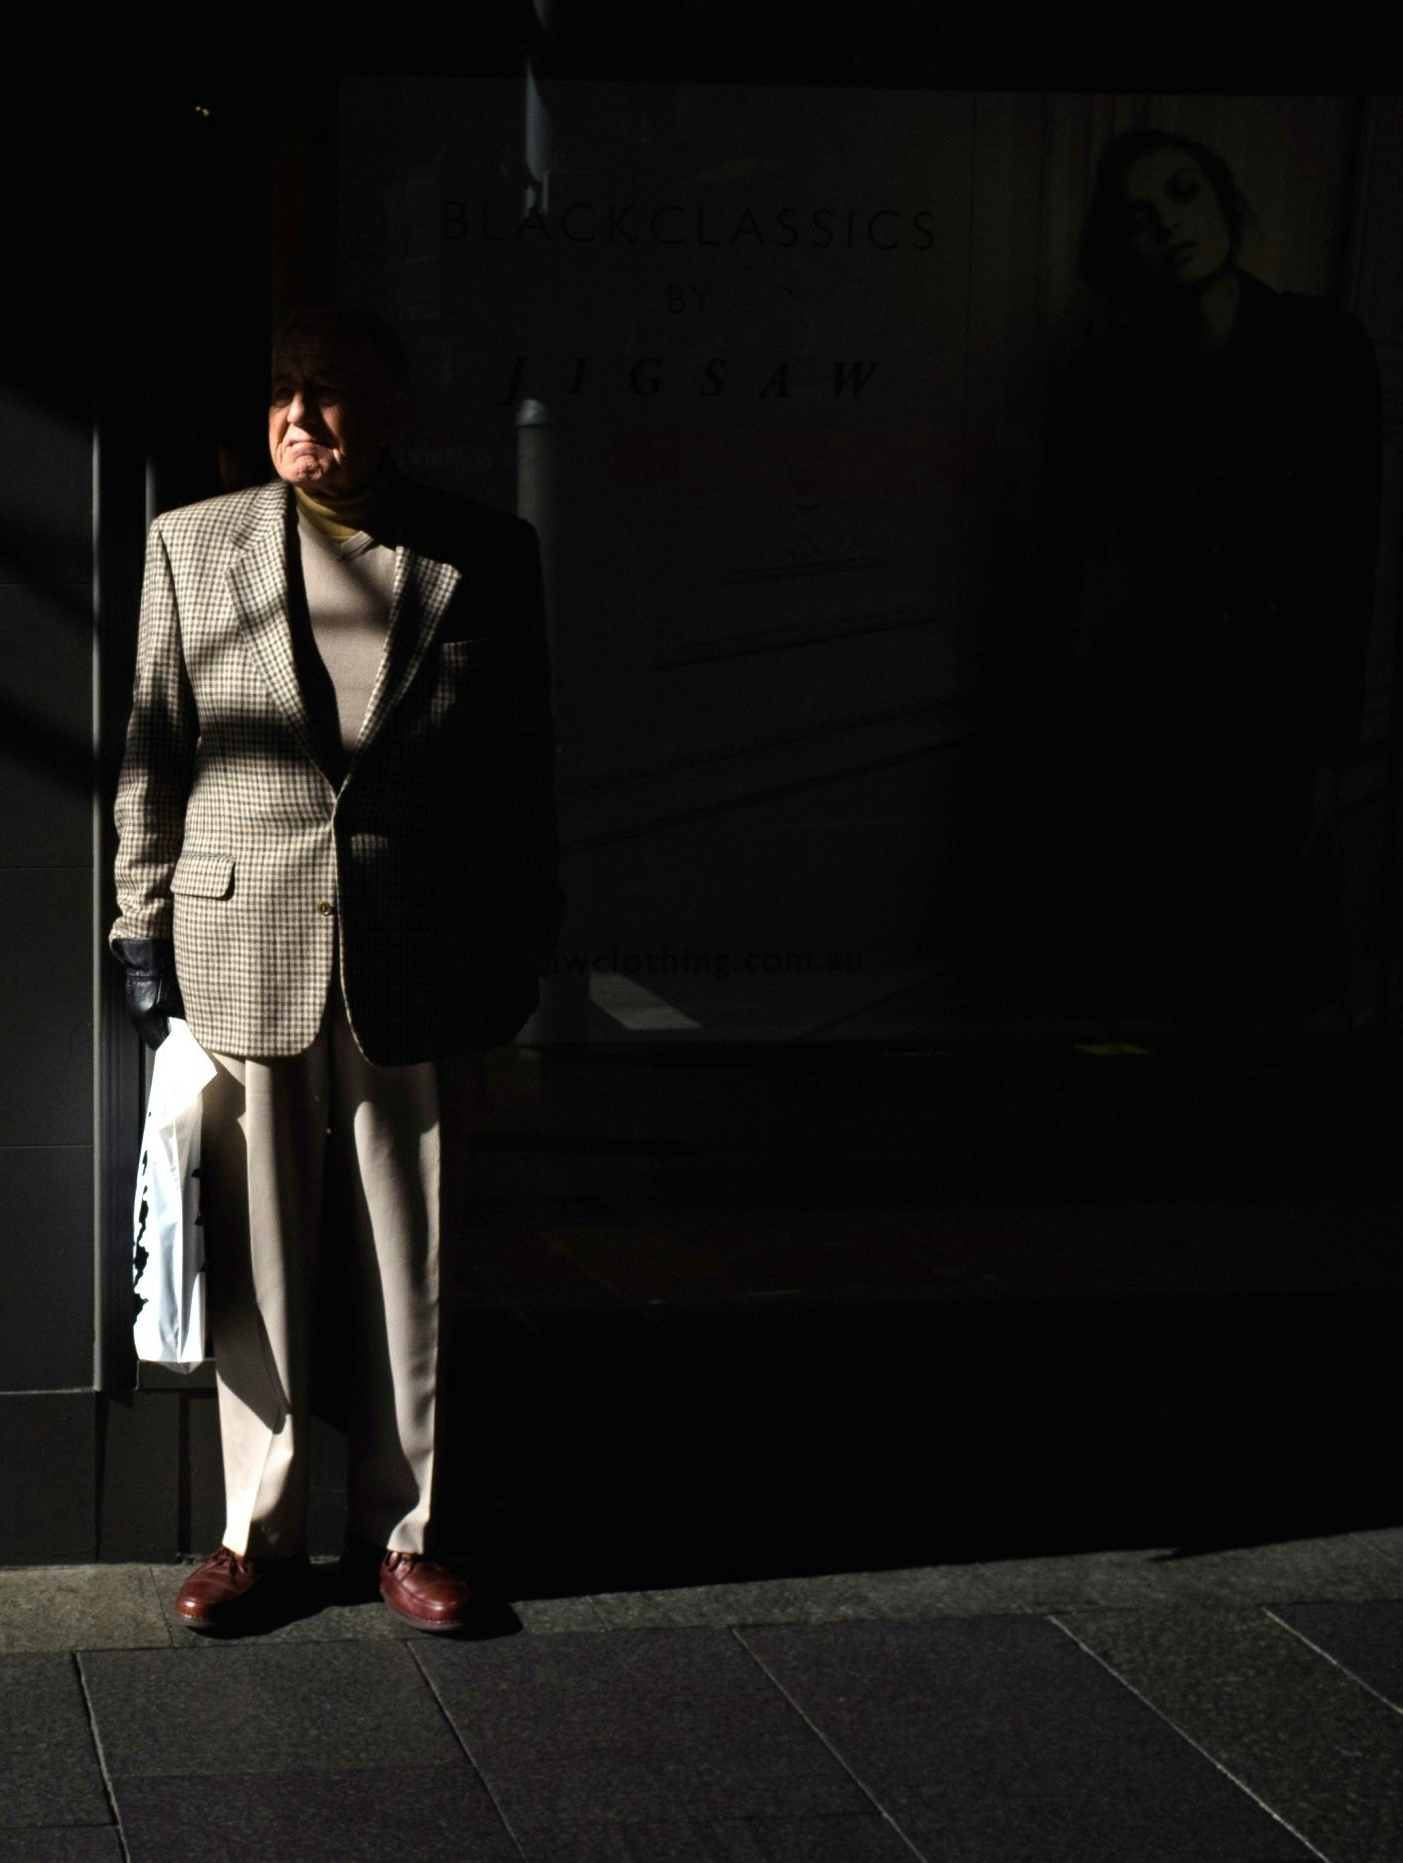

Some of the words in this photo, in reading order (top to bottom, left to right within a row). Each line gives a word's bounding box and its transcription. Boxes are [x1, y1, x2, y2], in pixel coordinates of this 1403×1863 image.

[442, 201, 935, 250] BLACKCLASSICS
[667, 283, 711, 315] BY
[502, 355, 878, 407] JIGSAW
